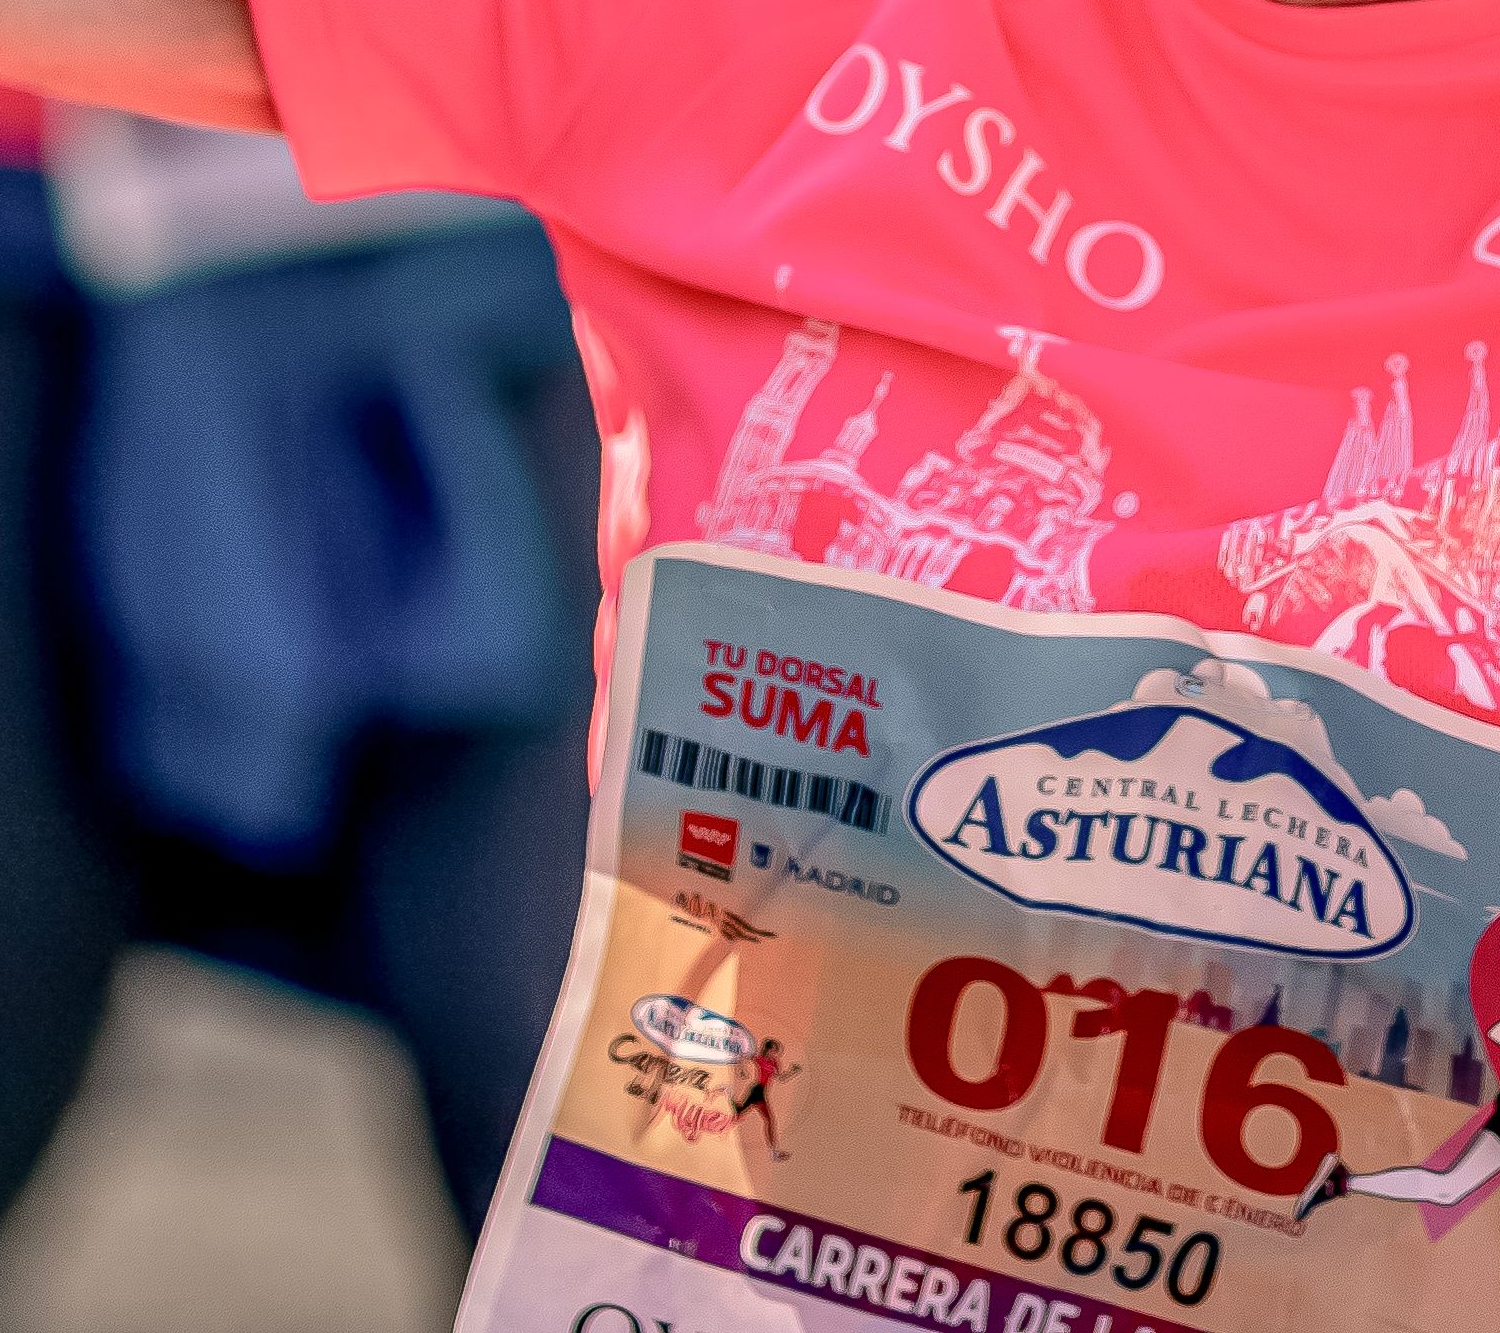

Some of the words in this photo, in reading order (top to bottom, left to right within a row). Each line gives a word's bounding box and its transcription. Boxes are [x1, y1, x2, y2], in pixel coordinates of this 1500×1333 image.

[803, 43, 1166, 312] OYSHO
[700, 671, 871, 758] SUMA
[703, 639, 747, 671] TU
[754, 648, 884, 710] DORSAL
[785, 855, 900, 907] MADRID
[943, 774, 1376, 940] ASTURIANA
[1036, 775, 1200, 811] CENTRAL
[1217, 798, 1370, 868] LECHERA
[904, 955, 1348, 1197] 016
[740, 1214, 990, 1333] CARRERA
[957, 1169, 1221, 1306] 18850
